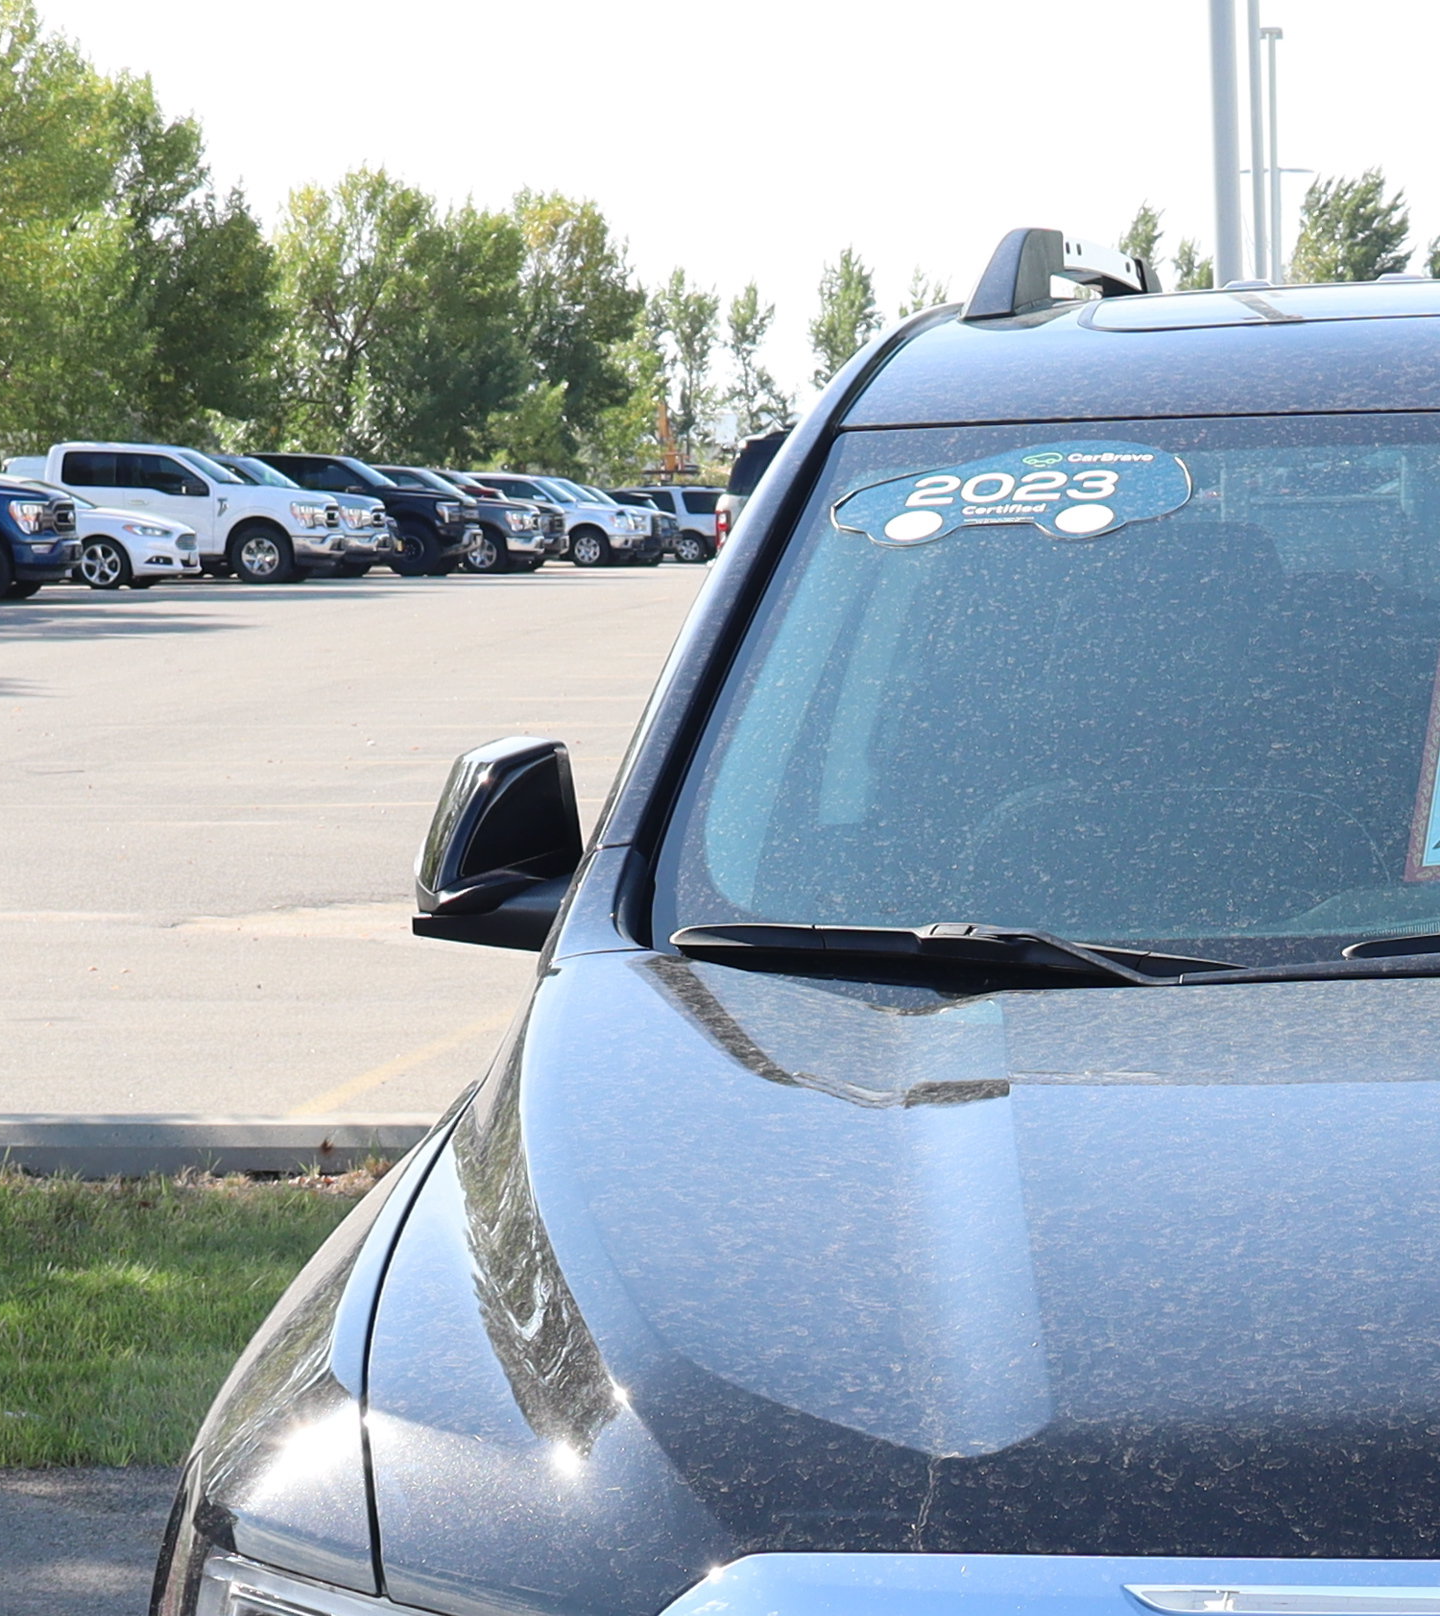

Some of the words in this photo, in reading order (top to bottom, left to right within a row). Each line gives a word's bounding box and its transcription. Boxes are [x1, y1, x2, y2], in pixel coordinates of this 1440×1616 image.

[1067, 452, 1154, 463] CarBravo
[904, 470, 1120, 506] 2023
[961, 503, 1047, 515] Certified
